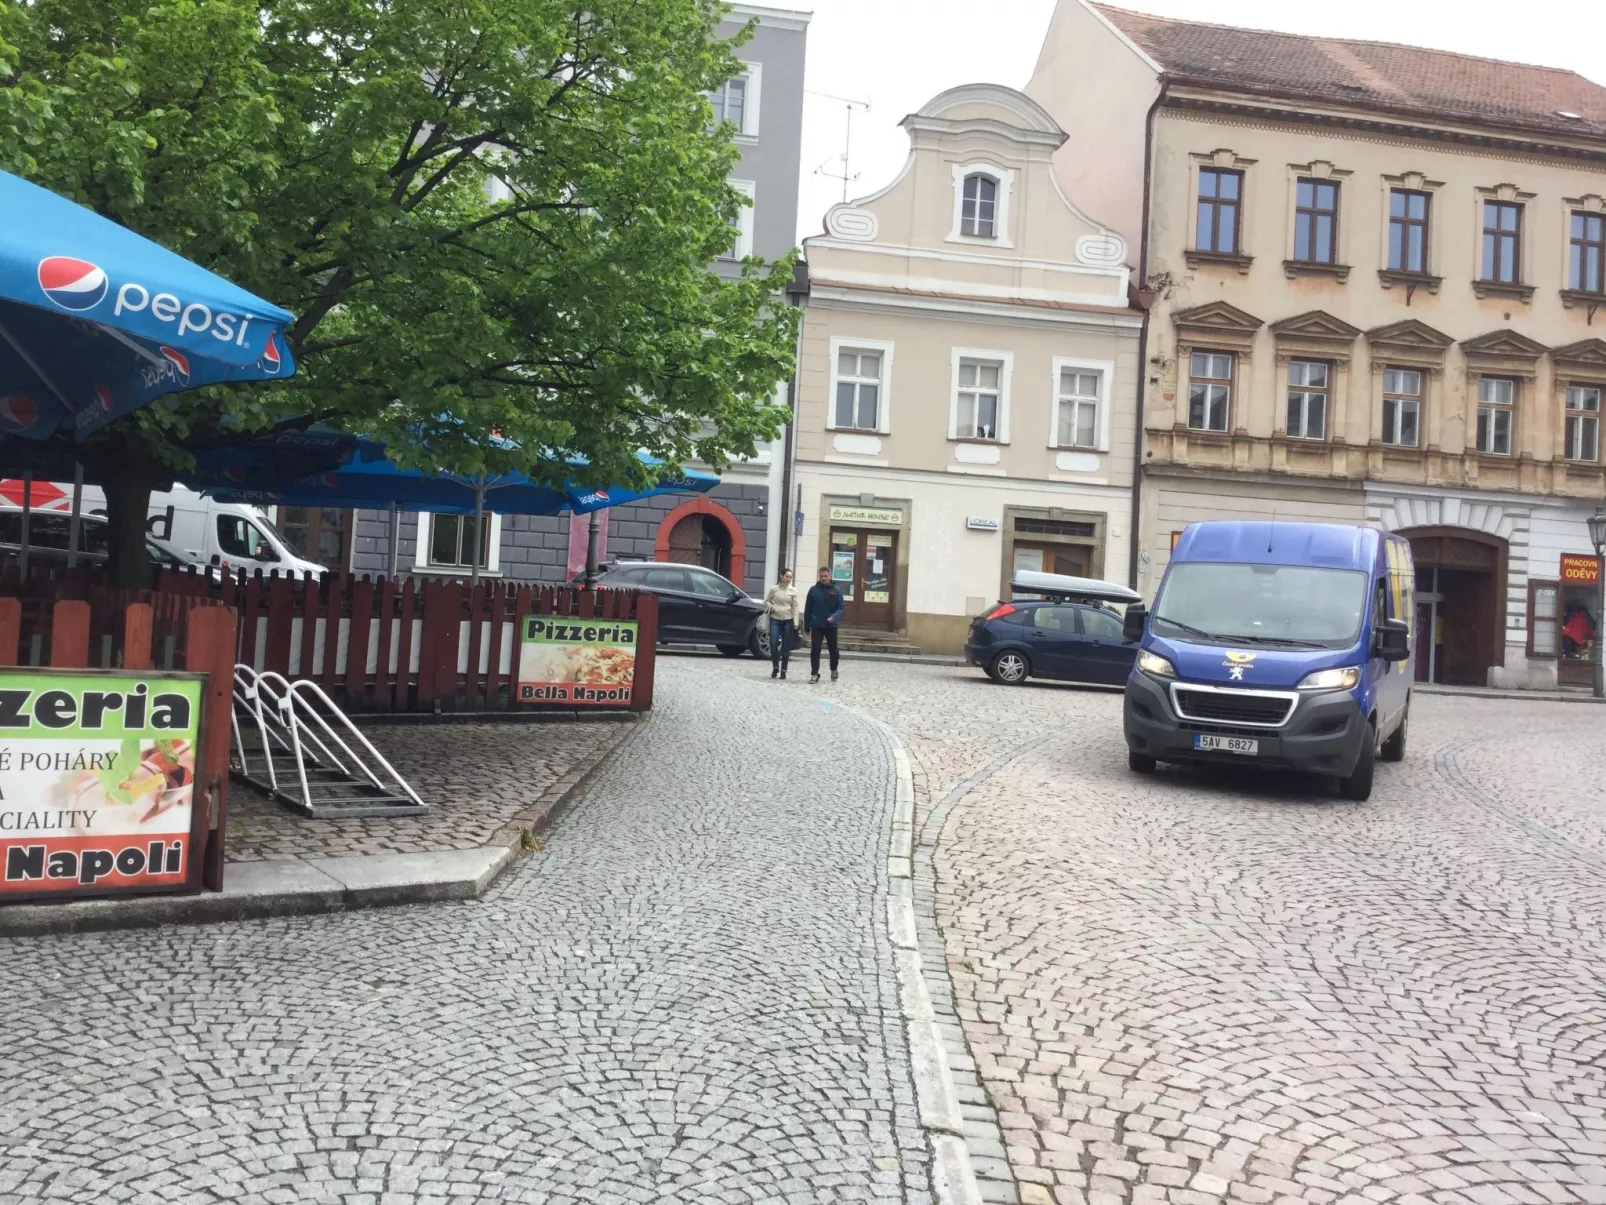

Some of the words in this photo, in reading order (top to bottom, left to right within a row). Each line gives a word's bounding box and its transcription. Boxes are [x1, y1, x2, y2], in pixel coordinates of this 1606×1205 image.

[113, 283, 254, 346] pepsi
[276, 434, 339, 447] pepsi
[1564, 559, 1597, 568] PRACOVN
[1566, 568, 1597, 579] ODĚVY
[527, 620, 634, 643] Pizzeria
[521, 685, 568, 700] Bella
[573, 687, 630, 703] Napoli
[1202, 736, 1221, 747] 5AV
[1228, 739, 1254, 750] 6827
[20, 749, 120, 771] POHÁRY
[5, 840, 183, 884] Napoli
